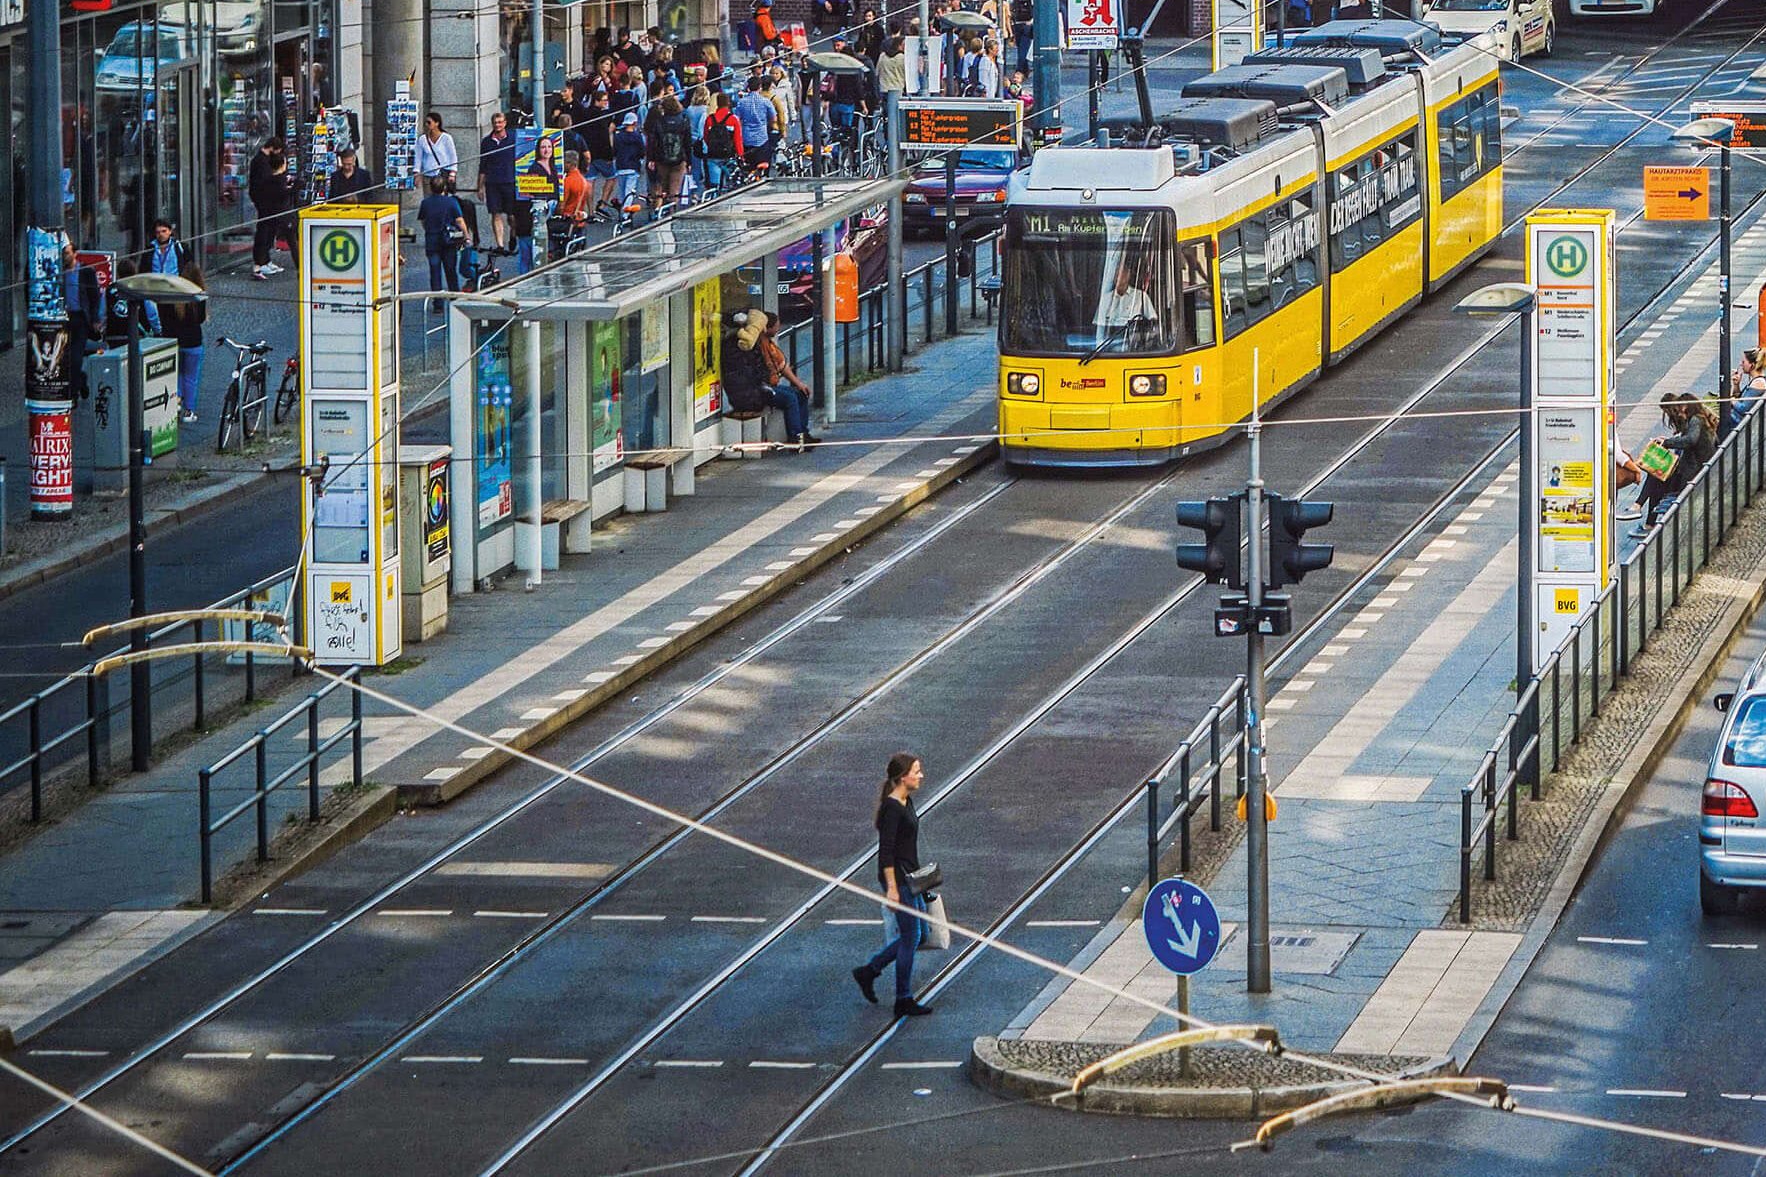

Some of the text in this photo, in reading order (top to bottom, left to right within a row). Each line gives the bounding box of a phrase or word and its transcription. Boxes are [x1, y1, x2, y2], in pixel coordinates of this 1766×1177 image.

[1030, 215, 1050, 233] M1
[330, 240, 350, 263] H
[1557, 245, 1577, 268] H
[31, 436, 69, 454] ATRIX
[31, 455, 69, 469] VERY
[31, 469, 70, 485] IGHT
[1557, 601, 1576, 611] BVG
